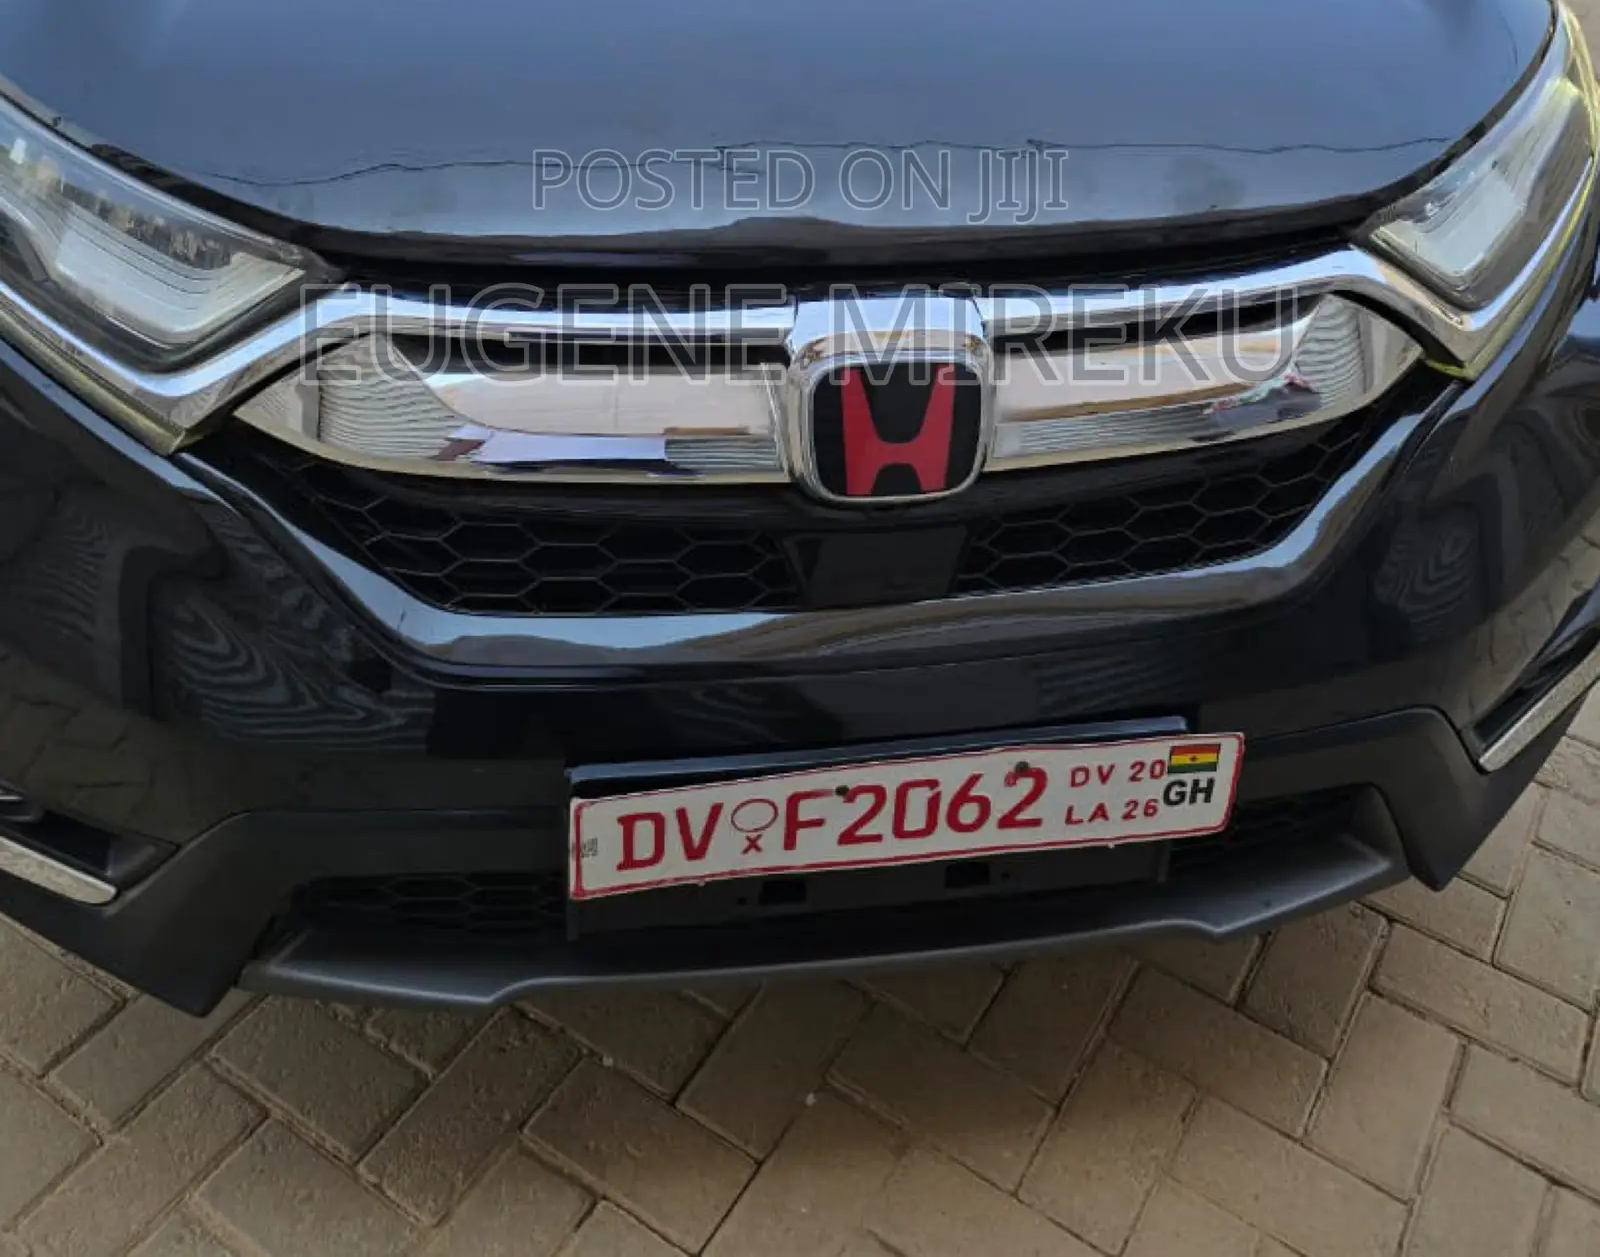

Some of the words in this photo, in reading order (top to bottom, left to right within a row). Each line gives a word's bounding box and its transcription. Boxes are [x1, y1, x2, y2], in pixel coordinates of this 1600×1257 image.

[1070, 763, 1115, 788] DV
[1128, 759, 1166, 782] 20
[1163, 777, 1215, 806] GH
[617, 803, 724, 871] DV
[783, 767, 1048, 850] F2062
[1065, 802, 1109, 825] LA
[1121, 799, 1159, 820] 26
